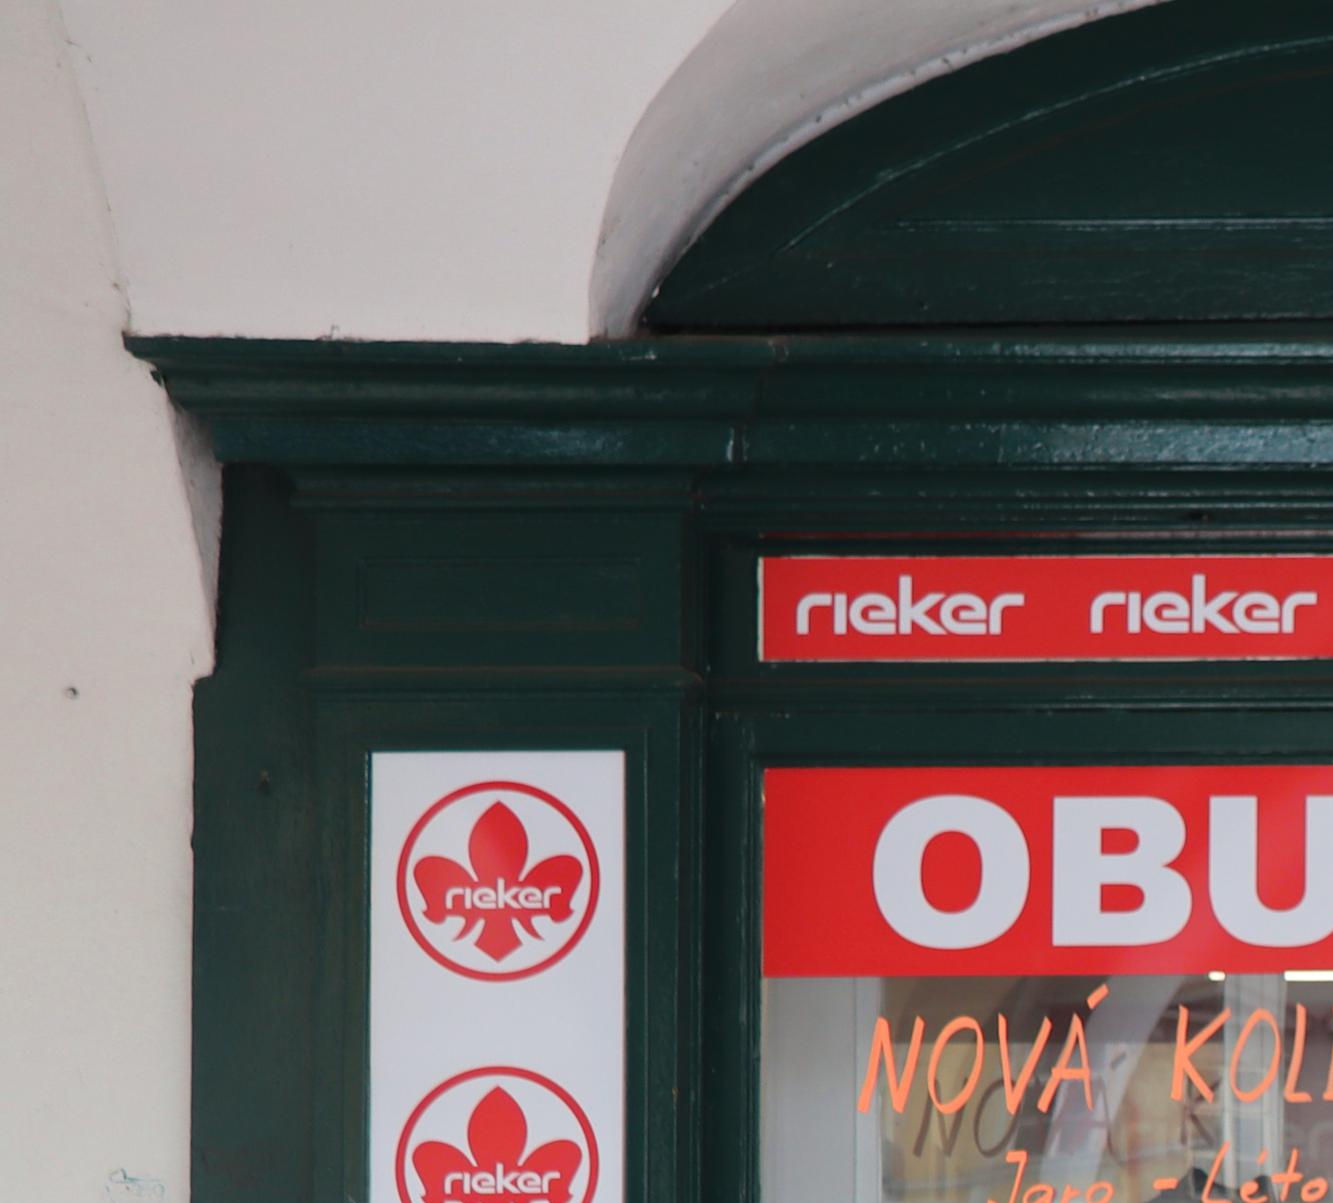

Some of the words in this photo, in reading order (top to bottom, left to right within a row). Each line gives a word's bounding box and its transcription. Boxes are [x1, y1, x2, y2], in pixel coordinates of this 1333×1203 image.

[796, 576, 1024, 635] rieker
[1089, 575, 1317, 634] rieker
[445, 878, 561, 909] rieker
[858, 985, 1110, 1117] NOVÁ
[444, 1163, 561, 1195] rieker
